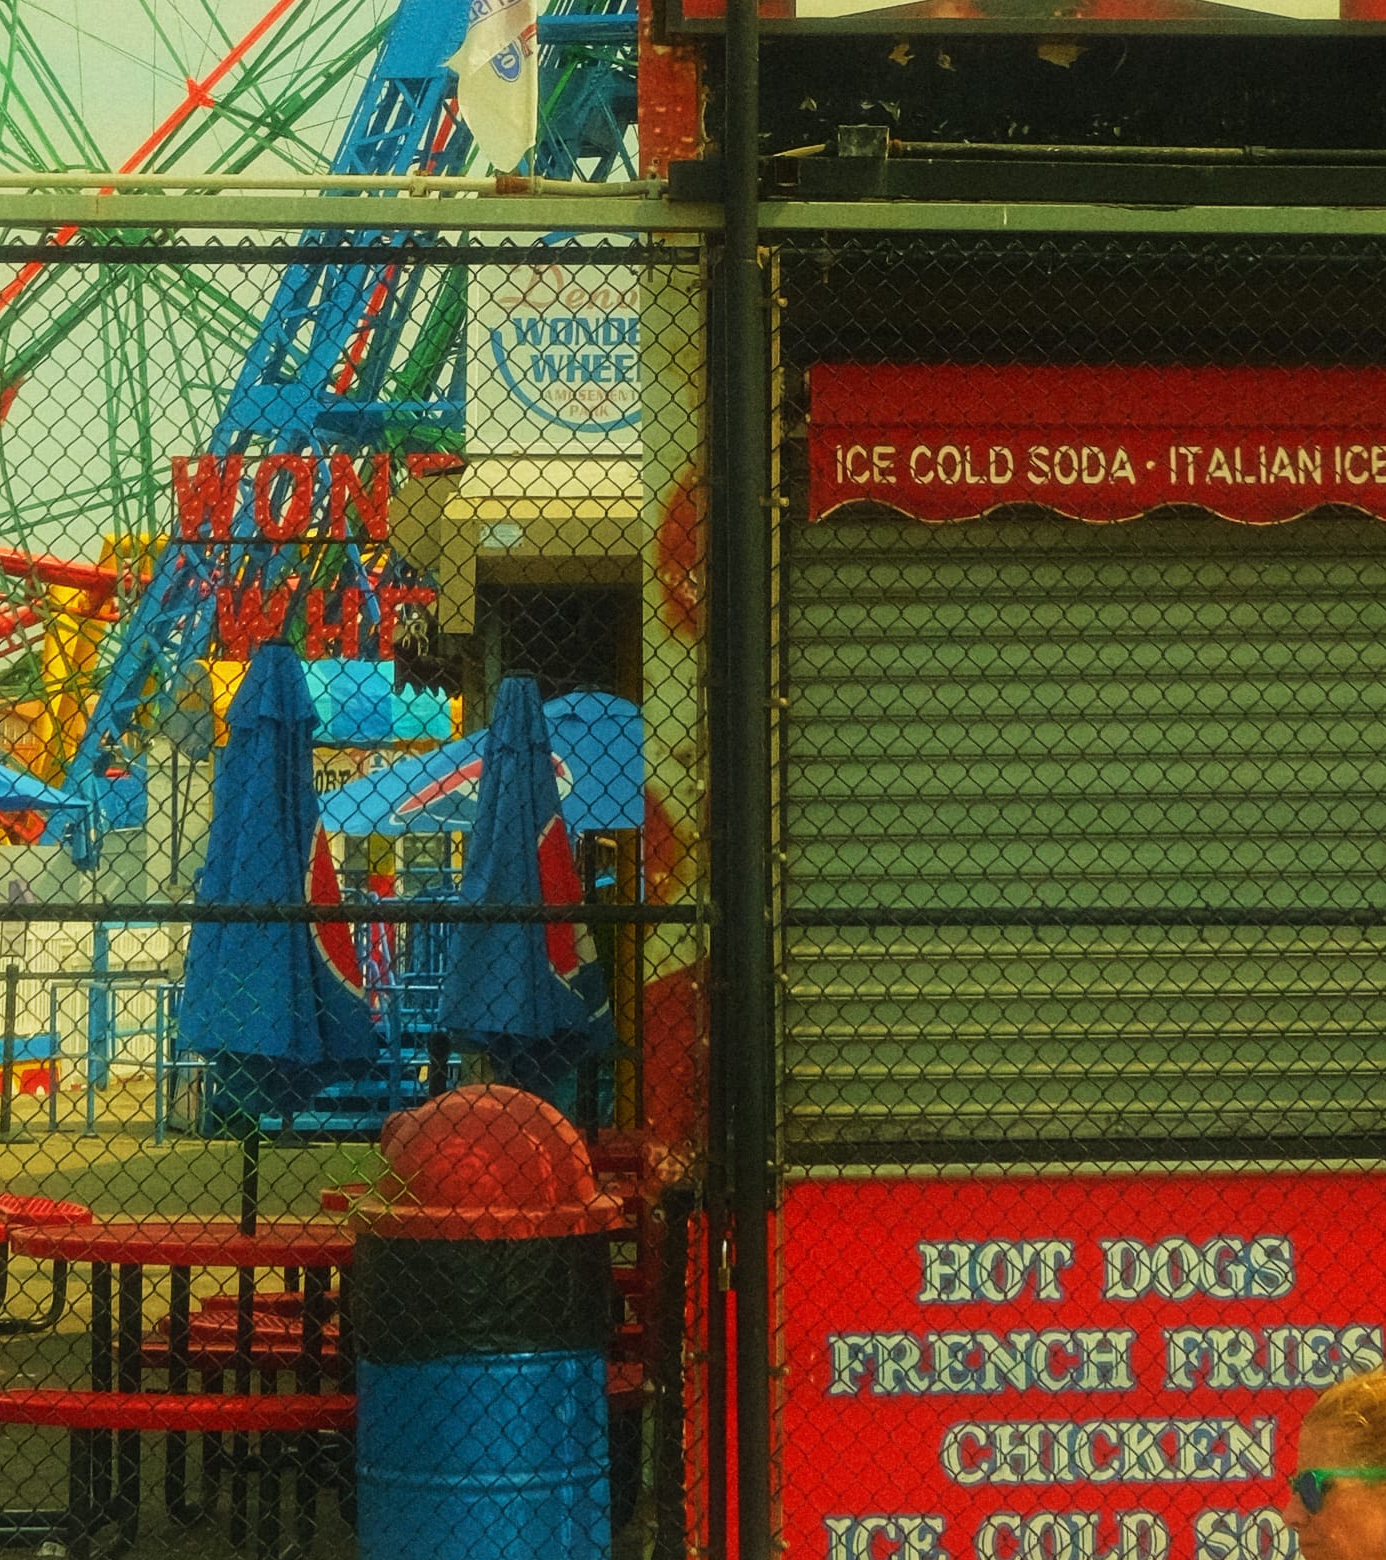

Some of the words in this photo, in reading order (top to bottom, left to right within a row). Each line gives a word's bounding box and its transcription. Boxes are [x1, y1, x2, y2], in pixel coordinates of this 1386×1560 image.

[569, 404, 610, 417] PARK
[835, 444, 897, 485] ICE
[909, 444, 1014, 485] COLD
[1027, 444, 1136, 485] SODA
[1168, 444, 1323, 485] ITALIAN
[918, 1237, 1074, 1304] HOT
[1101, 1235, 1295, 1301] DOGS
[827, 1329, 1137, 1396] FRENCH
[939, 1416, 1277, 1484] CHICKEN
